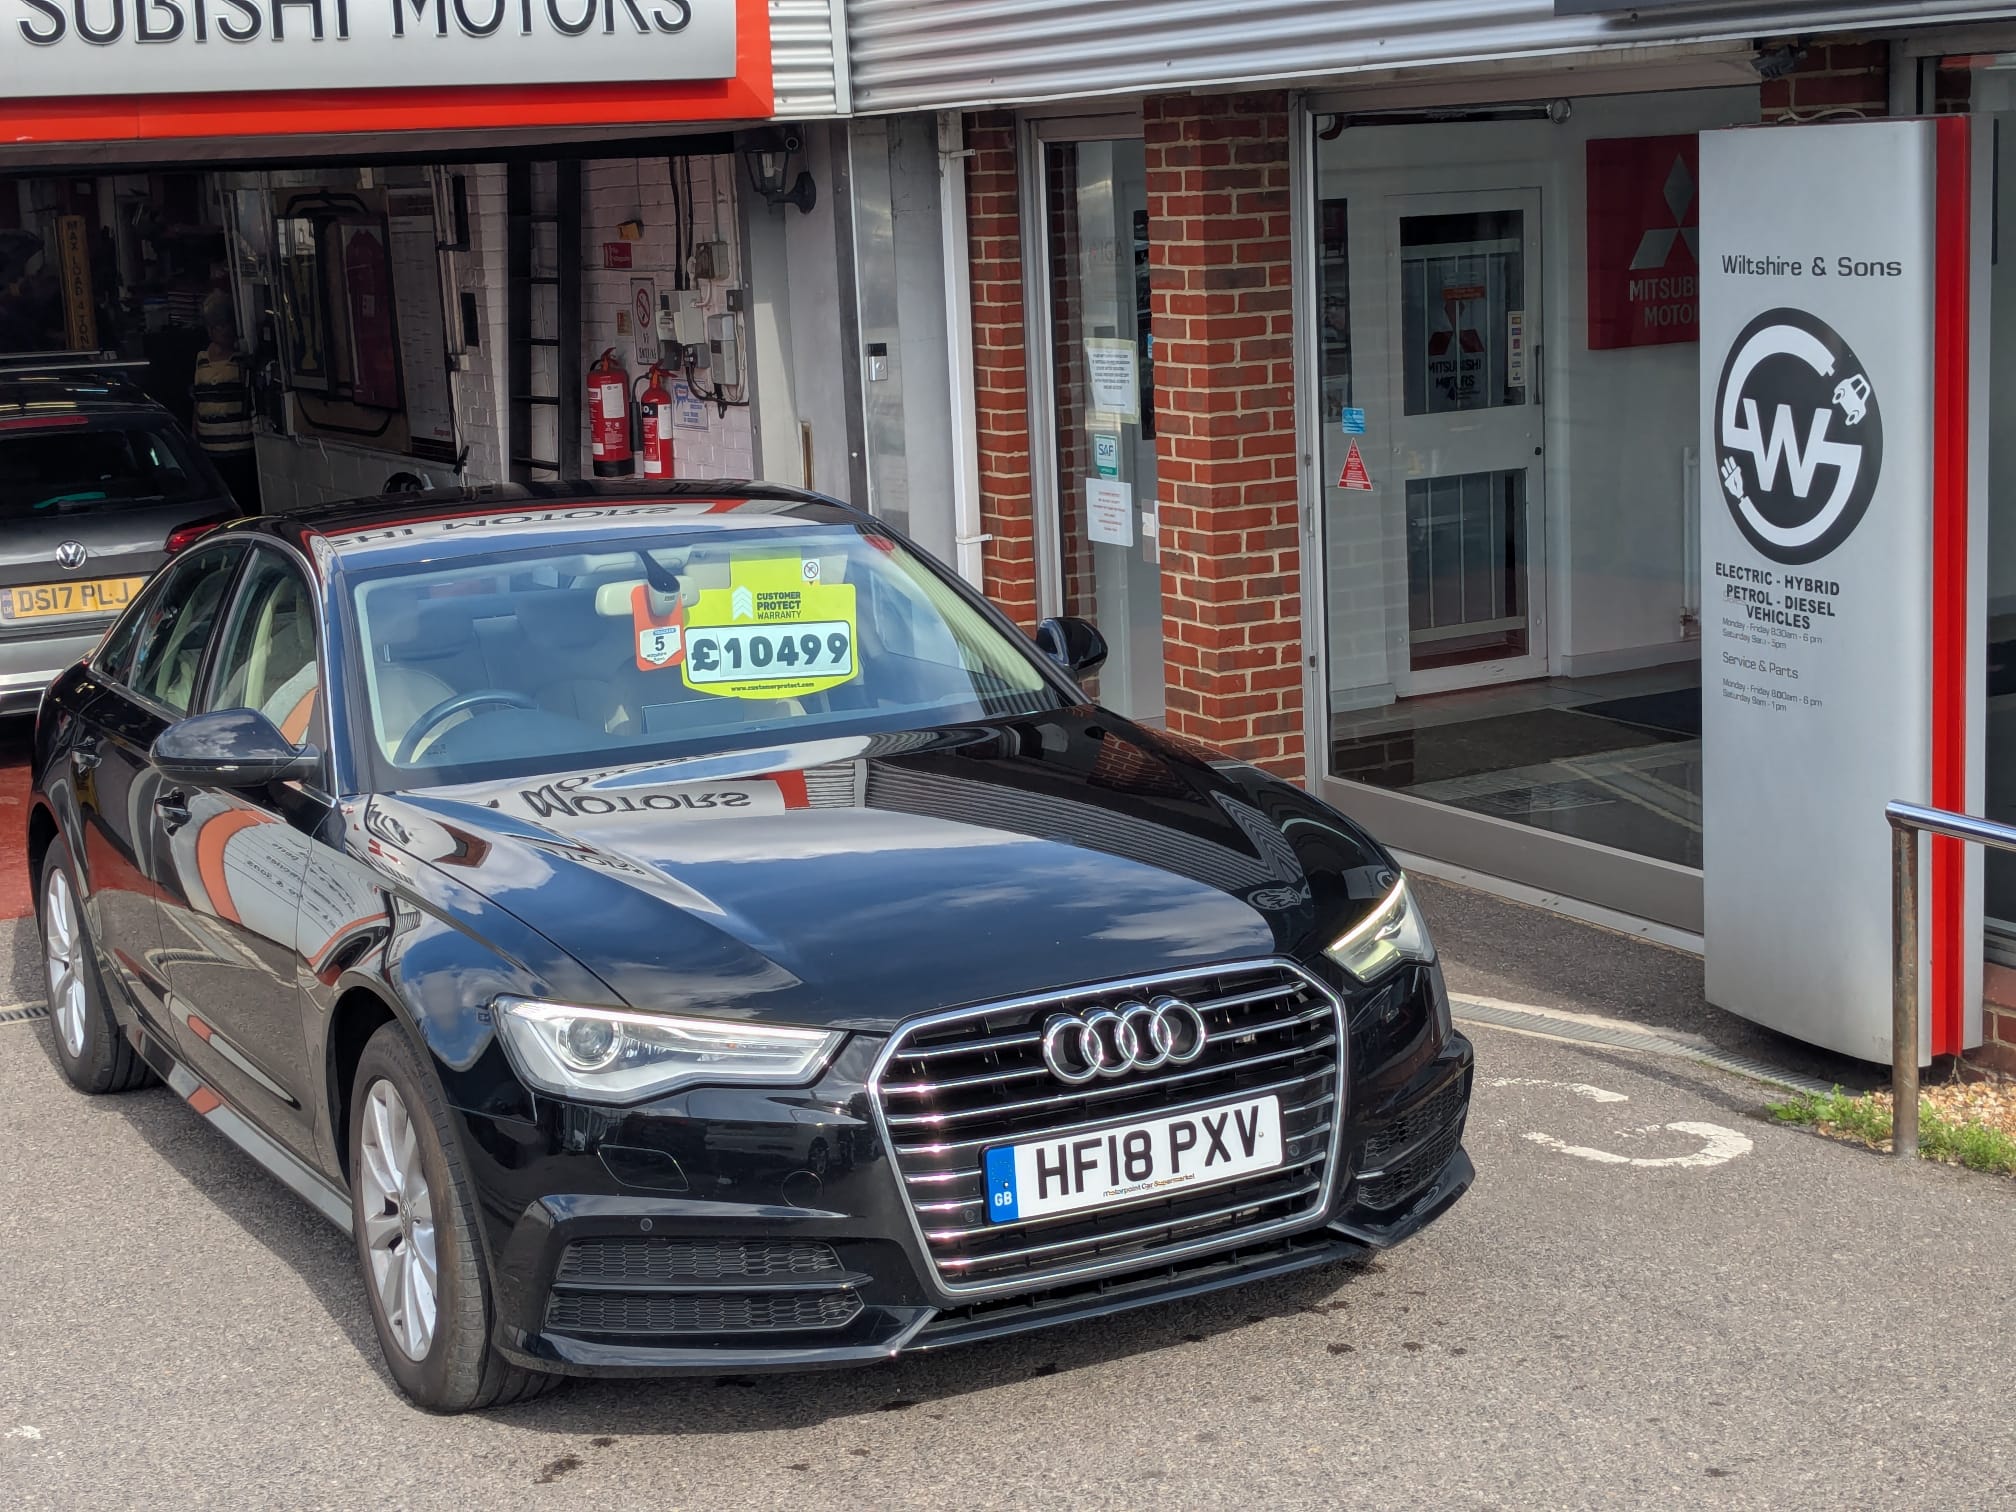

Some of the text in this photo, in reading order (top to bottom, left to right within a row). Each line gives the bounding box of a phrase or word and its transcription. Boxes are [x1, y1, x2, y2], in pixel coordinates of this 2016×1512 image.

[1721, 255, 1902, 277] Wiltshire & Sons
[1715, 562, 1772, 585] ELECTRIC
[1784, 575, 1840, 595] HYBRID
[18, 582, 129, 612] DS17 PLJ
[756, 591, 801, 602] CUSTOMER
[756, 600, 801, 611] PROTECT
[1726, 584, 1773, 606] PETROL
[1784, 595, 1836, 617] DIESEL
[757, 610, 802, 620] WARRANTY
[1746, 604, 1811, 630] VEHICLES
[1722, 617, 1745, 631] Monday
[1750, 623, 1770, 636] Friday
[1722, 628, 1750, 643] Saturday
[655, 636, 665, 651] 5
[691, 632, 849, 672] £10499
[1722, 651, 1799, 680] Service & Parts
[731, 682, 815, 691] www.customerprotect.com
[1722, 678, 1745, 692] Monday
[1750, 684, 1770, 698] Friday
[1722, 688, 1750, 704] Saturday
[1036, 1105, 1259, 1200] HF18 PXV
[1154, 1173, 1195, 1187] Supermarket
[994, 1191, 1013, 1206] GB
